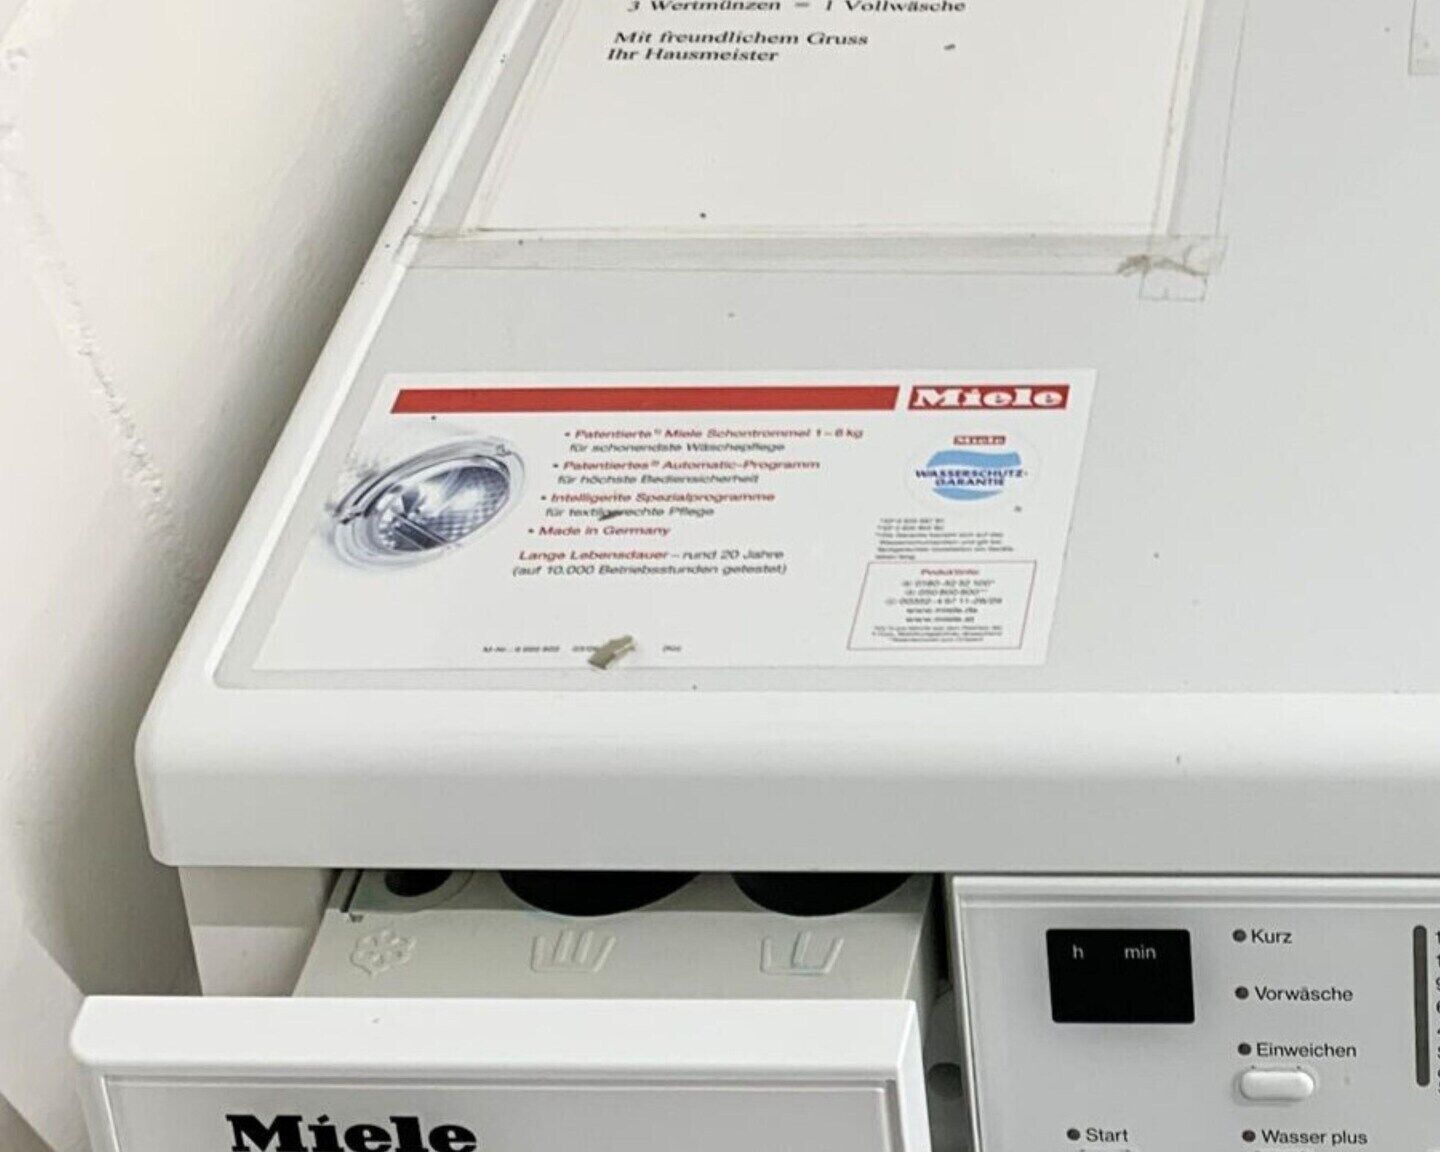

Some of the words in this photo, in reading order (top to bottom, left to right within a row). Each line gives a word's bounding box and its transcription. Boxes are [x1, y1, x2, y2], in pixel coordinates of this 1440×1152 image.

[651, 0, 781, 11] Wertmünzen
[845, 0, 966, 12] Vollwäsche
[613, 31, 651, 45] Mit
[659, 30, 799, 45] freundlichem
[806, 31, 869, 46] Gruss
[607, 48, 640, 61] Ihr
[645, 48, 780, 62] Hausmeister
[912, 386, 1065, 409] Miele
[664, 428, 703, 438] Miele
[708, 428, 811, 439] Schontrommel
[570, 442, 590, 453] für
[592, 443, 682, 452] schonendste
[686, 442, 786, 454] Wäschepflege
[662, 460, 821, 472] Automatic-Programm
[558, 473, 577, 485] für
[579, 474, 637, 484] höchste
[914, 468, 1029, 479] WASSERSCHUTZ-
[934, 477, 1005, 487] GARANTIE
[550, 492, 632, 504] Intelligente
[635, 491, 776, 504] Spezialprogramme
[546, 506, 565, 518] für
[669, 507, 715, 518] Pflege
[538, 525, 581, 536] Made
[585, 525, 598, 536] in
[602, 525, 671, 538] Germany
[518, 551, 567, 563] Lange
[570, 550, 669, 561] Lebensdauer
[682, 550, 717, 561] rund
[720, 550, 740, 561] 20
[743, 550, 785, 561] Jahre
[512, 564, 543, 577] (auf
[546, 565, 595, 576] 10.000
[598, 564, 719, 576] Betriebsstunden
[722, 564, 787, 577] getestet)
[1251, 928, 1293, 945] Kurz
[1072, 944, 1085, 960] h
[1124, 944, 1157, 960] min
[1254, 984, 1354, 1002] Vorwäsche
[1256, 1041, 1357, 1059] Einweichen
[1085, 1126, 1129, 1143] Start
[1261, 1128, 1326, 1145] Wasser
[1330, 1128, 1369, 1147] plus
